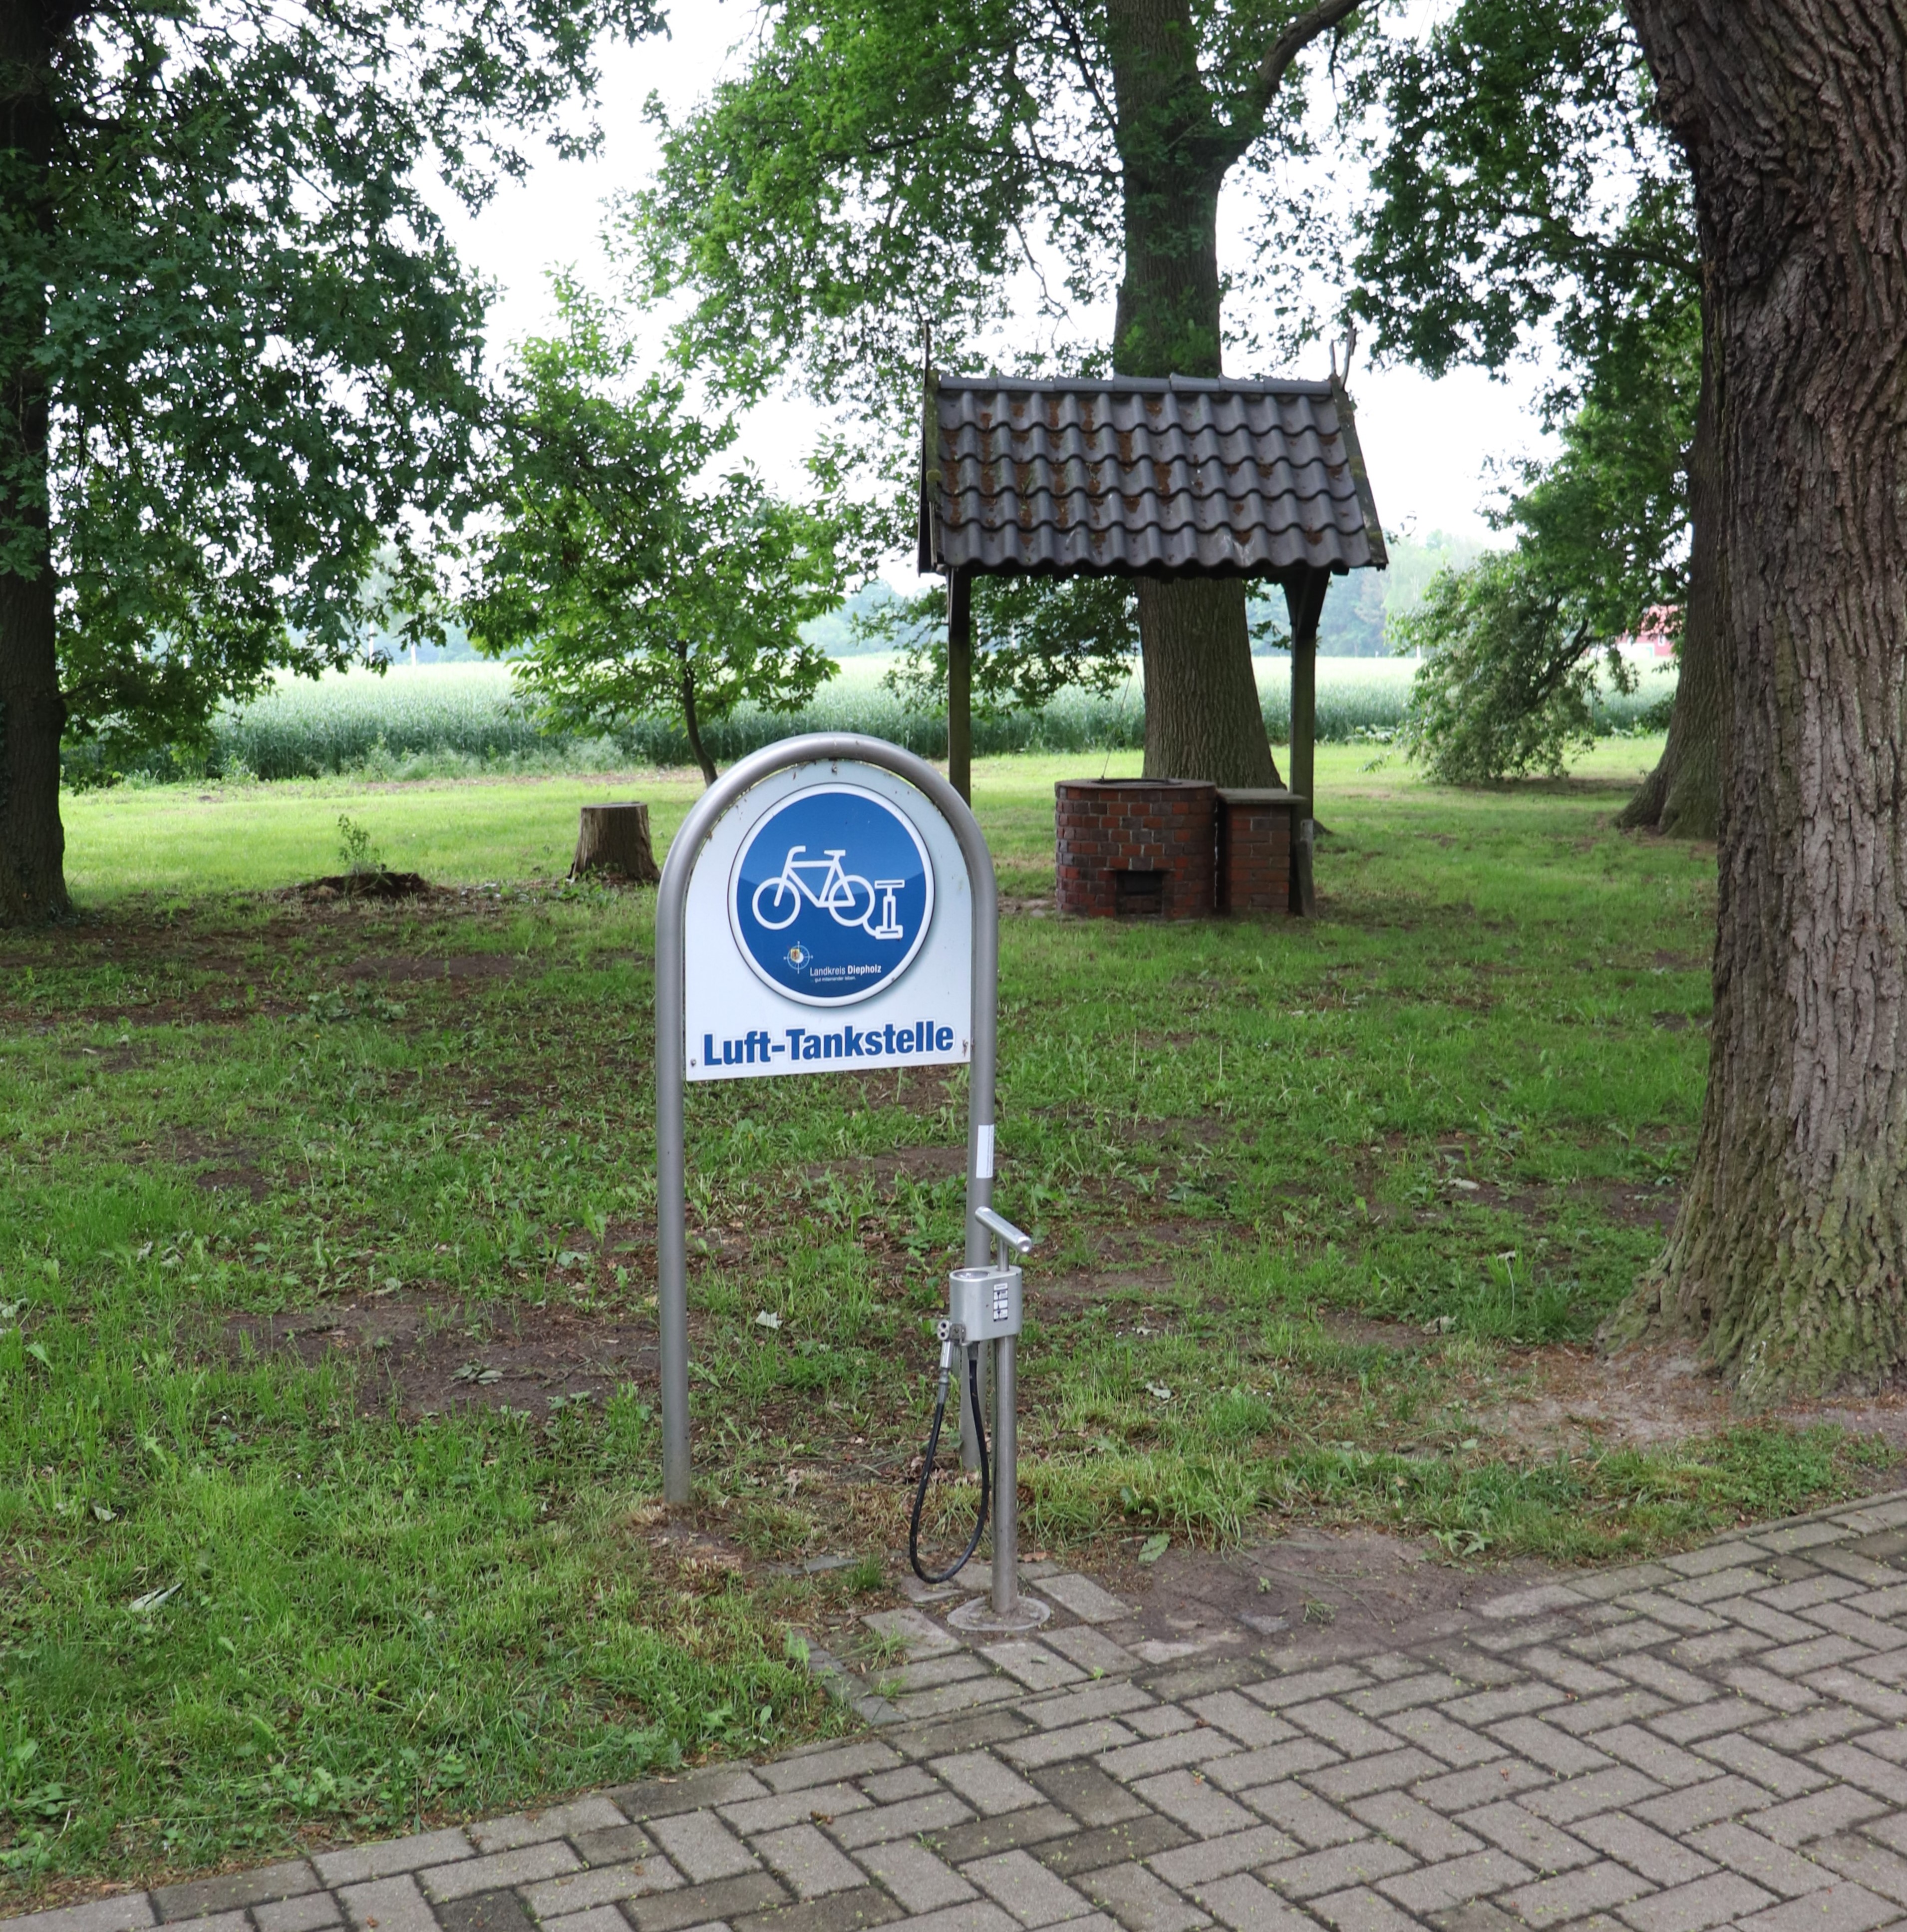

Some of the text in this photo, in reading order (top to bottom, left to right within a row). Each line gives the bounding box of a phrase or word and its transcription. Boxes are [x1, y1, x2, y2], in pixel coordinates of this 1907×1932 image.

[810, 964, 882, 976] Landkreis Diepholz
[703, 1020, 954, 1066] Luft-Tankstelle
